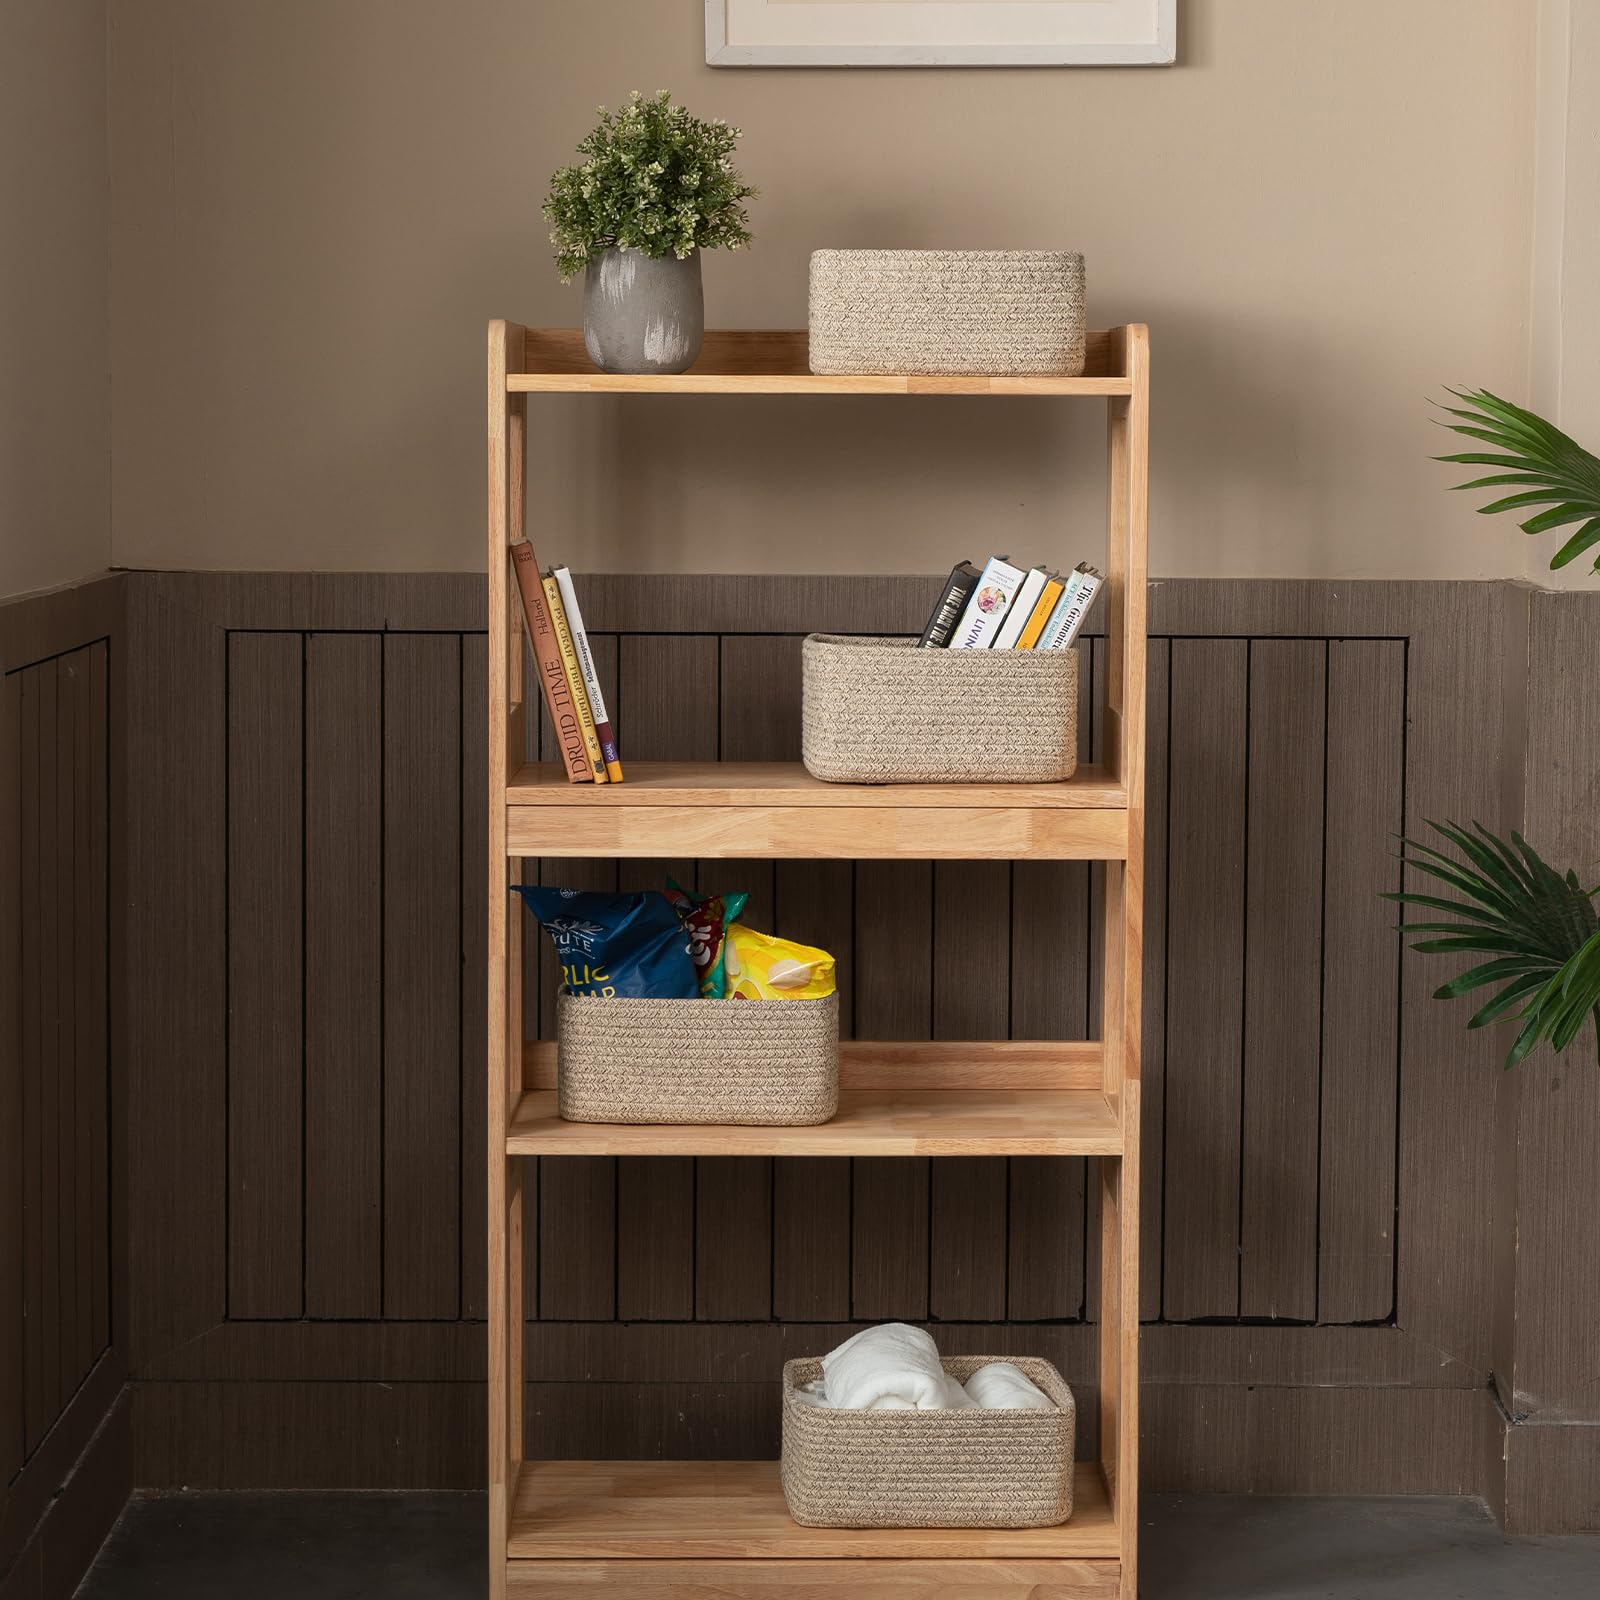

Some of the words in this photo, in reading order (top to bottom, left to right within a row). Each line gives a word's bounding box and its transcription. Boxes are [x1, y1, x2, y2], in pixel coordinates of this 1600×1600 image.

[946, 586, 967, 608] TAKE
[531, 598, 549, 635] Holland
[554, 607, 573, 658] РУССКАЯ
[929, 626, 948, 644] THE
[936, 605, 957, 629] BACK
[576, 632, 594, 683] Selbstmanagement
[545, 659, 571, 711] TIME
[592, 687, 603, 718] Schröder
[560, 714, 588, 775] DRUID
